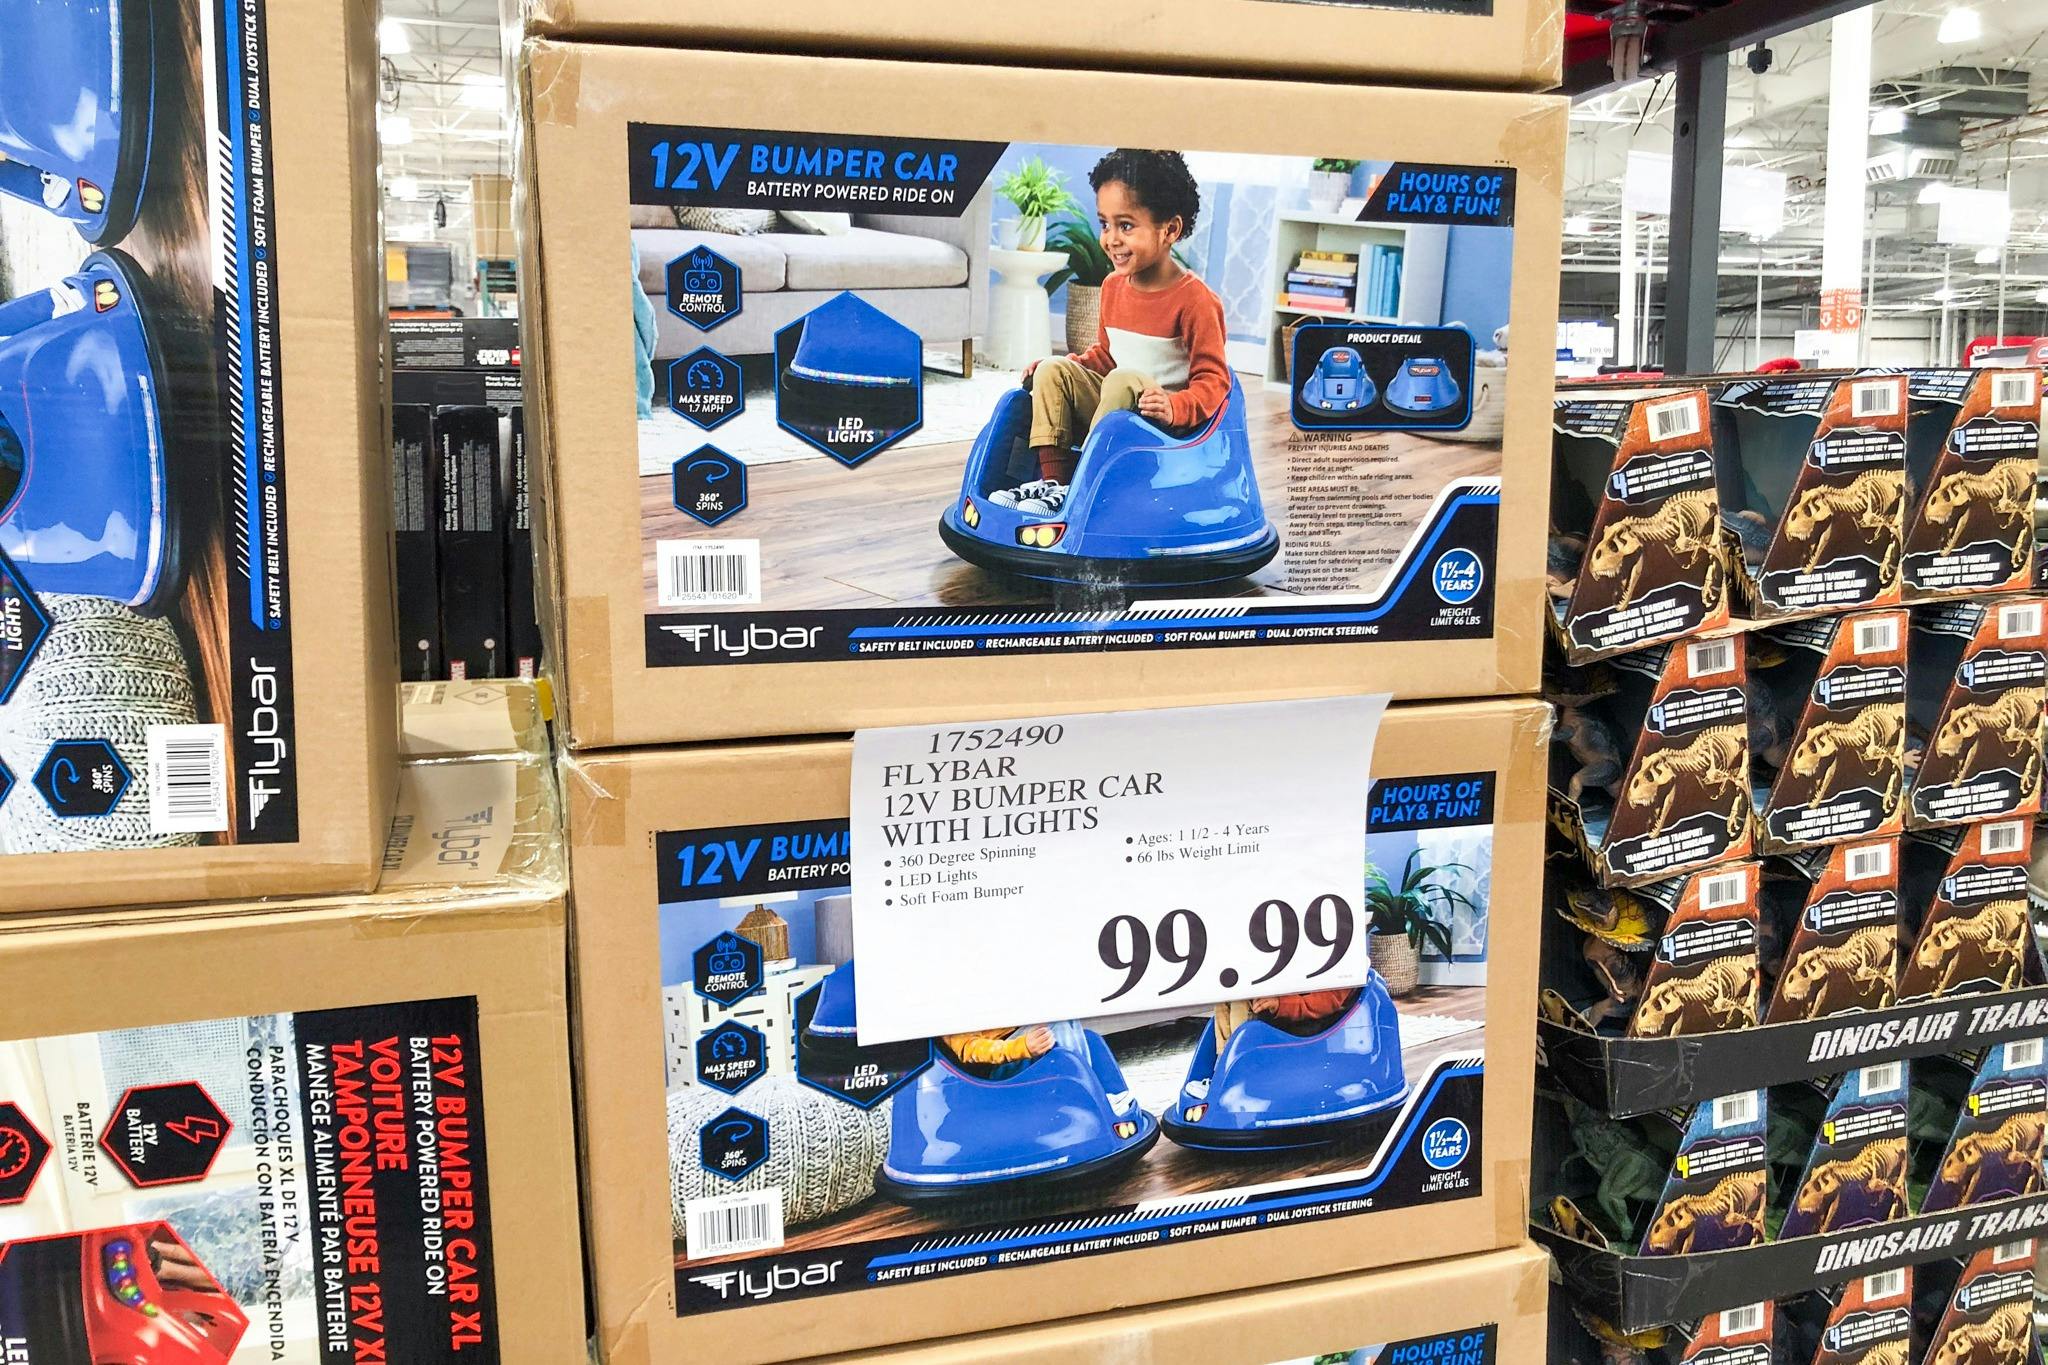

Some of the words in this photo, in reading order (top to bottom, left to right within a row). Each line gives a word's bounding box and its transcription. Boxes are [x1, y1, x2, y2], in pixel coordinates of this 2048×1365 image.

[651, 141, 740, 191] 12V
[750, 145, 884, 180] BUMPER
[894, 151, 958, 182] CAR
[747, 181, 812, 198] BATTERY
[814, 184, 889, 201] POWERED
[893, 186, 928, 203] RIDE
[931, 189, 954, 204] ON
[1400, 172, 1469, 194] HOURS
[1474, 175, 1502, 195] OF
[1387, 193, 1448, 214] PLAY&
[1453, 195, 1500, 216] FUN!
[679, 302, 726, 313] CONTROL
[682, 293, 723, 304] REMOTE
[1347, 333, 1390, 344] PRODUCT
[1391, 334, 1422, 344] DETAIL
[679, 395, 701, 405] MAX
[703, 394, 733, 405] SPEED
[689, 403, 699, 413] 1.7
[700, 403, 724, 413] MPH
[838, 417, 863, 430] LED
[827, 429, 875, 444] LIGHTS
[1303, 433, 1352, 442] WARNING
[1319, 444, 1347, 452] INJURIES
[695, 500, 723, 511] SPINS
[1439, 579, 1474, 591] YEARS
[5, 597, 23, 650] LIGHTS
[1430, 617, 1453, 626] LIMIT
[1453, 617, 1464, 626] 66
[1465, 616, 1480, 626] LBS
[1439, 607, 1474, 617] WEIGHT
[859, 642, 896, 652] SAFETY
[897, 641, 921, 651] BELT
[922, 640, 974, 651] INCLUDED
[986, 637, 1062, 648] RECHARGEABLE
[1063, 635, 1103, 647] BATTERY
[1105, 633, 1154, 644] INCLUDED
[1164, 631, 1188, 642] SOFT
[1189, 630, 1216, 641] FOAM
[1218, 629, 1256, 640] BUMPER
[1266, 628, 1291, 639] DUAL
[1292, 627, 1333, 638] JOYSTICK
[1335, 625, 1379, 637] STEERING
[928, 724, 1064, 754] 1752490
[102, 764, 114, 795] SPINS
[882, 756, 1018, 787] FLYBAR
[884, 791, 940, 818] 12V
[952, 779, 1088, 811] BUMPER
[1099, 772, 1165, 798] CAR
[1382, 783, 1450, 805] HOURS
[1455, 781, 1482, 799] OF
[1370, 803, 1429, 824] PLAY&
[1434, 799, 1481, 819] FUN!
[881, 817, 971, 848] WITH
[982, 806, 1099, 839] LIGHTS
[1137, 833, 1172, 846] Ages:
[1179, 830, 1184, 841] 1
[1191, 827, 1209, 841] 1/2
[1222, 825, 1230, 837] 4
[1235, 823, 1270, 836] Years
[677, 838, 762, 887] 12V
[899, 854, 924, 868] 360
[929, 851, 975, 867] Degree
[980, 845, 1037, 862] Spinning
[1137, 851, 1153, 864] 66
[1158, 849, 1175, 862] lbs
[1180, 845, 1222, 860] Weight
[1227, 842, 1260, 855] Limit
[767, 863, 828, 882] BATTERY
[900, 873, 932, 888] LED
[937, 869, 978, 886] Lights
[900, 893, 927, 907] Soft
[932, 889, 968, 905] Foam
[973, 884, 1025, 902] Bumper
[1098, 893, 1354, 1003] 99.99
[704, 980, 749, 993] CONTROL
[707, 972, 746, 984] REMOTE
[1806, 1010, 1960, 1063] DINOSAUR
[432, 1034, 465, 1088] 12V
[704, 1062, 726, 1074] MAX
[727, 1059, 756, 1072] SPEED
[854, 1064, 878, 1078] LED
[305, 1043, 334, 1126] MANÈGE
[409, 1037, 433, 1116] BATTERY
[844, 1074, 889, 1090] LIGHTS
[246, 1048, 273, 1157] CONDUCCIÓN
[270, 1046, 293, 1163] PARACHOQUES
[368, 1036, 408, 1170] VOITURE
[77, 1102, 96, 1161] BATTERIE
[126, 1109, 145, 1164] BATTERY
[142, 1123, 158, 1146] 12V
[68, 1156, 79, 1172] 12V
[331, 1040, 380, 1274] TAMPONNEUSE
[435, 1096, 475, 1230] BUMPER
[1429, 1145, 1462, 1159] YEARS
[84, 1166, 98, 1186] 12V
[279, 1167, 295, 1186] XL
[313, 1129, 345, 1223] ALIMENTÉ
[415, 1119, 441, 1213] POWERED
[257, 1163, 273, 1196] CON
[281, 1191, 297, 1210] DE
[259, 1202, 282, 1265] BATERÍA
[284, 1215, 299, 1228] 12
[286, 1233, 299, 1242] V
[320, 1227, 342, 1264] PAR
[422, 1218, 444, 1261] RIDE
[1814, 1219, 1960, 1275] DINOSAUR
[425, 1265, 446, 1295] ON
[446, 1238, 479, 1303] CAR
[265, 1269, 286, 1361] ENCENDIDA
[323, 1268, 349, 1352] BATTERIE
[350, 1282, 385, 1333] 12V
[450, 1311, 482, 1351] XL
[5, 1338, 29, 1365] LE
[1391, 1338, 1456, 1365] HOURS
[1459, 1332, 1486, 1351] OF
